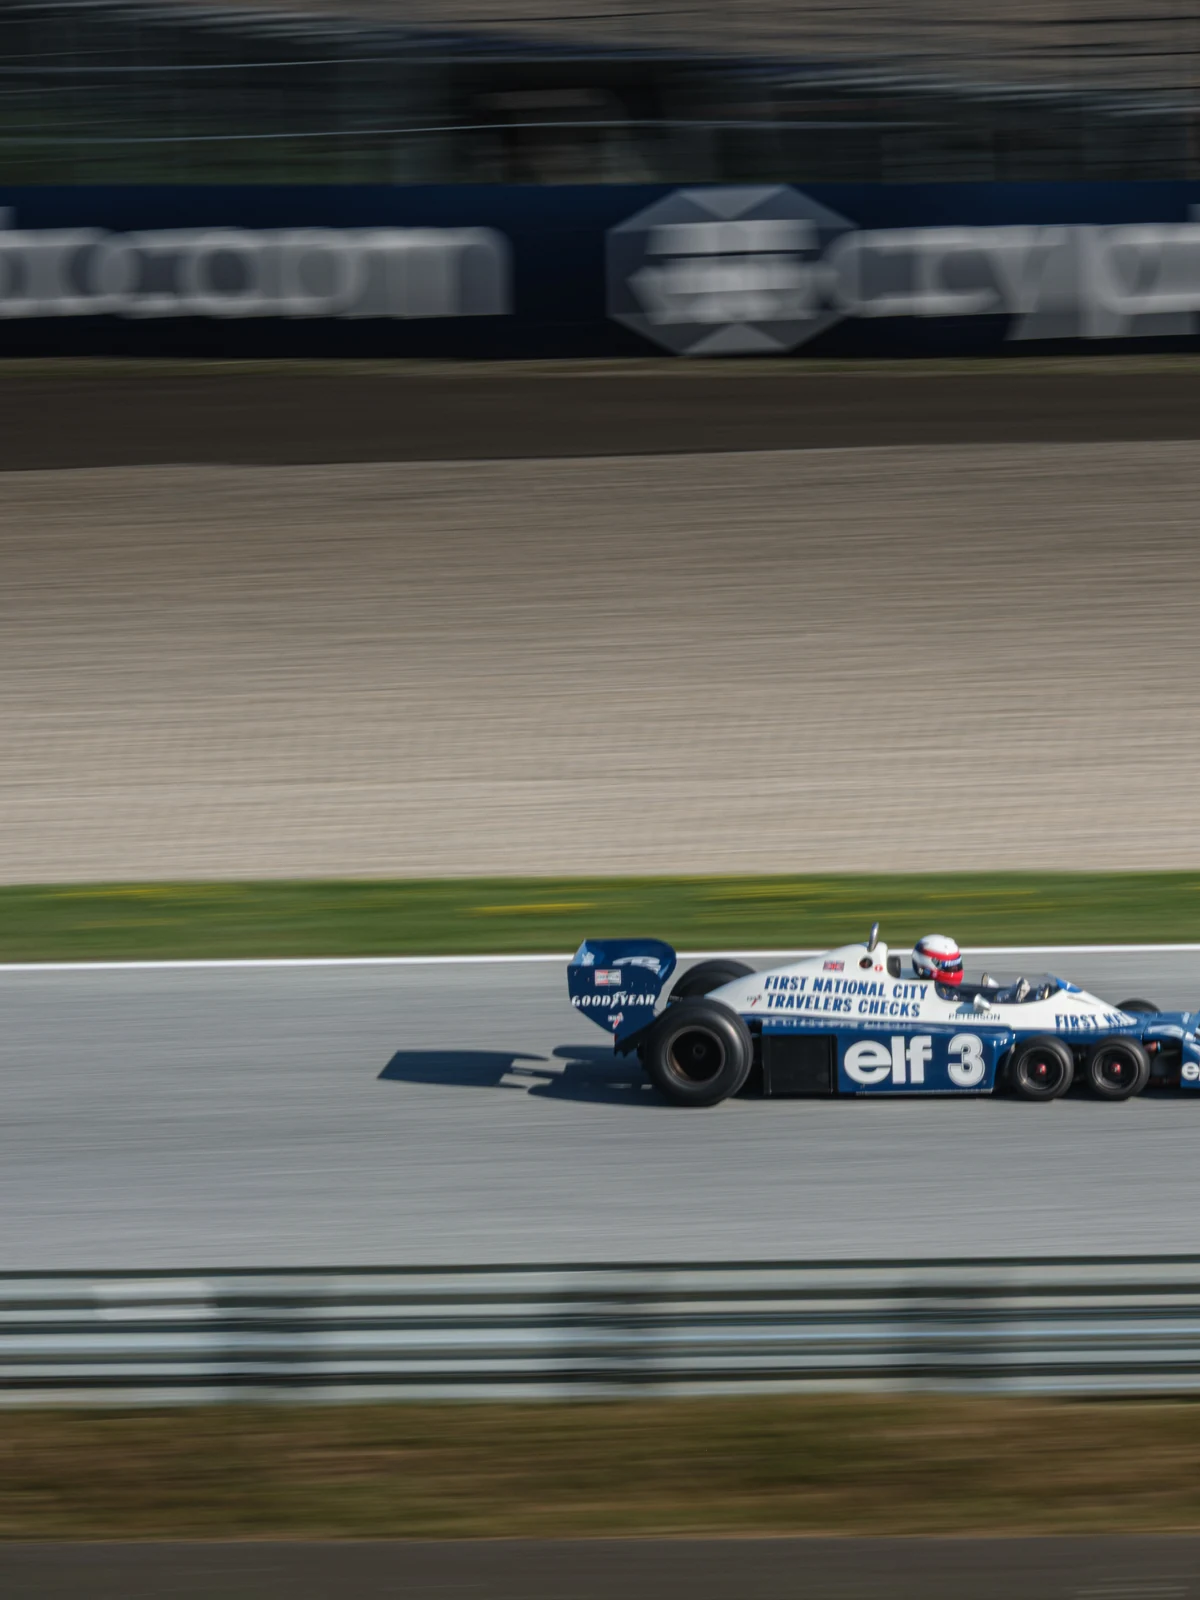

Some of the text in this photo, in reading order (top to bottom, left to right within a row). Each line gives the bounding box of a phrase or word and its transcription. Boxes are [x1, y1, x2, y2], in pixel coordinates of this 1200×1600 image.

[571, 993, 656, 1007] GOODYEAR
[764, 975, 928, 1001] FIRST NATIONAL CITY
[766, 992, 852, 1012] TRAVELERS
[857, 998, 921, 1018] CHECKS
[1054, 1013, 1099, 1029] FIRST
[843, 1035, 933, 1085] elf
[947, 1032, 986, 1088] 3
